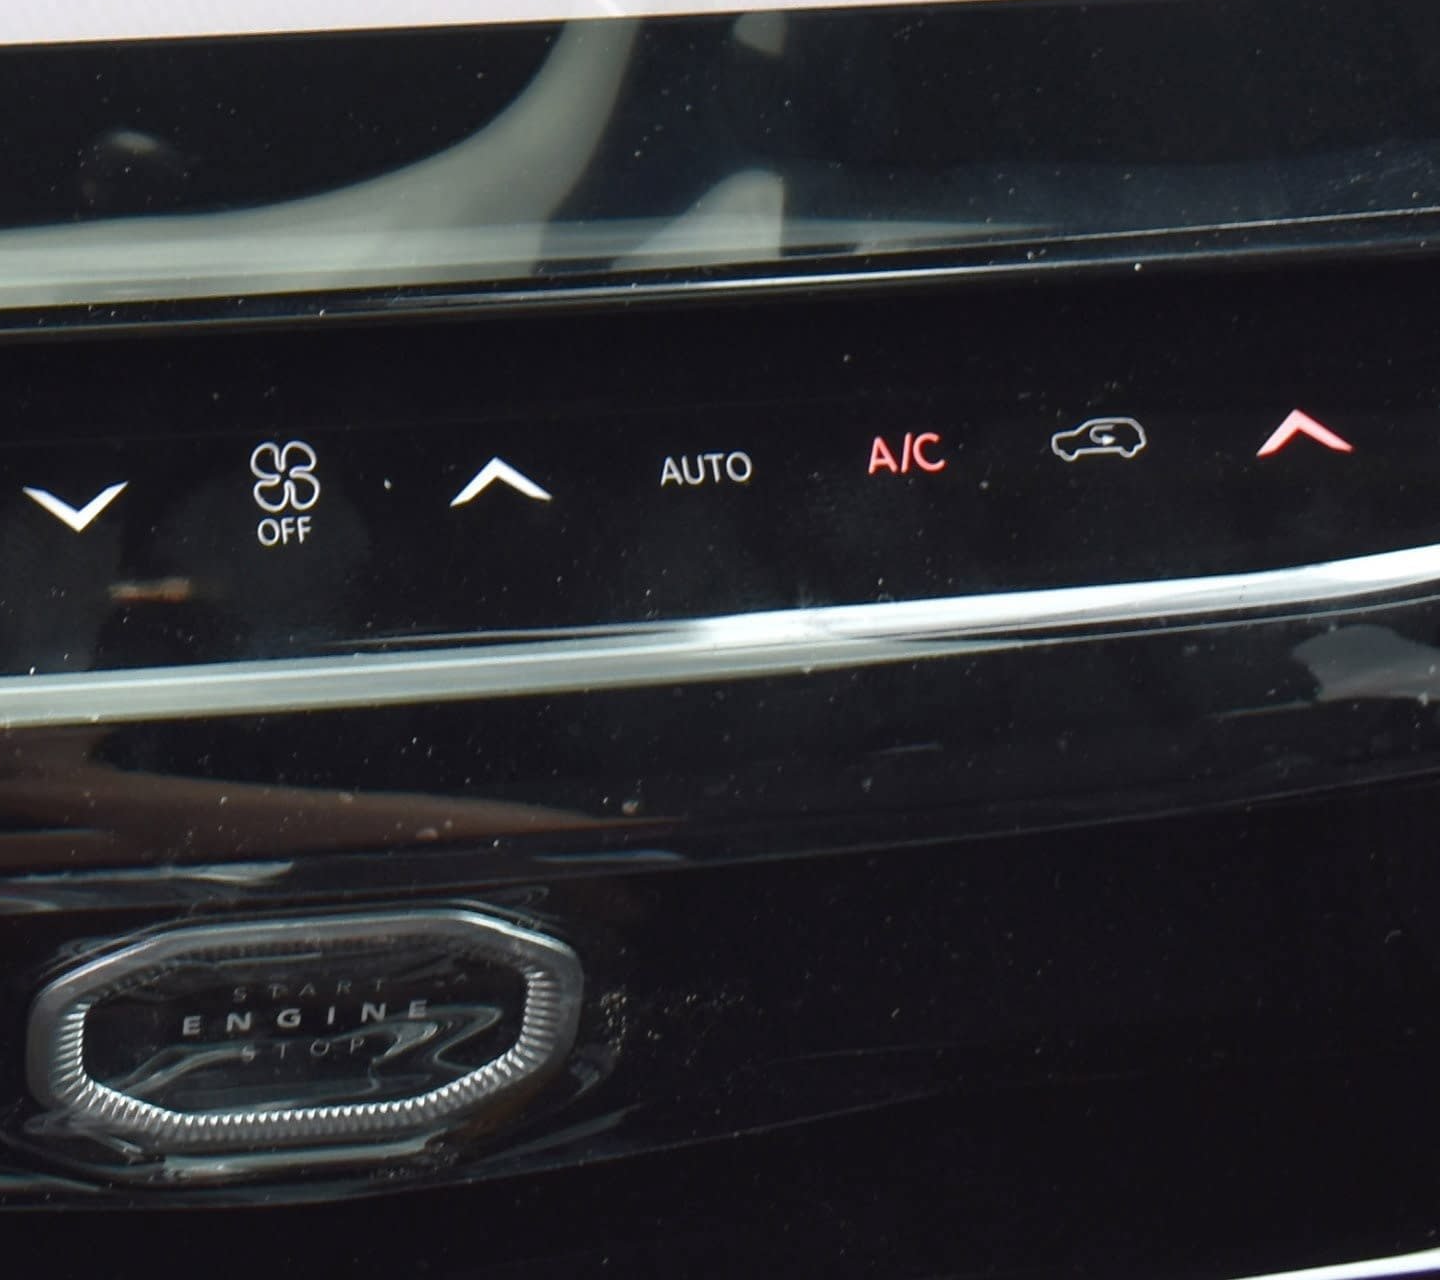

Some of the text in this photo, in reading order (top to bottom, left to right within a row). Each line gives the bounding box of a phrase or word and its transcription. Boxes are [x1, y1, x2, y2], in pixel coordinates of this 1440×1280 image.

[660, 452, 754, 487] AUTO
[867, 433, 947, 475] A/C
[257, 517, 313, 547] OFF
[232, 977, 386, 1002] START
[181, 999, 428, 1036] ENGINE
[240, 1037, 366, 1063] STOP
